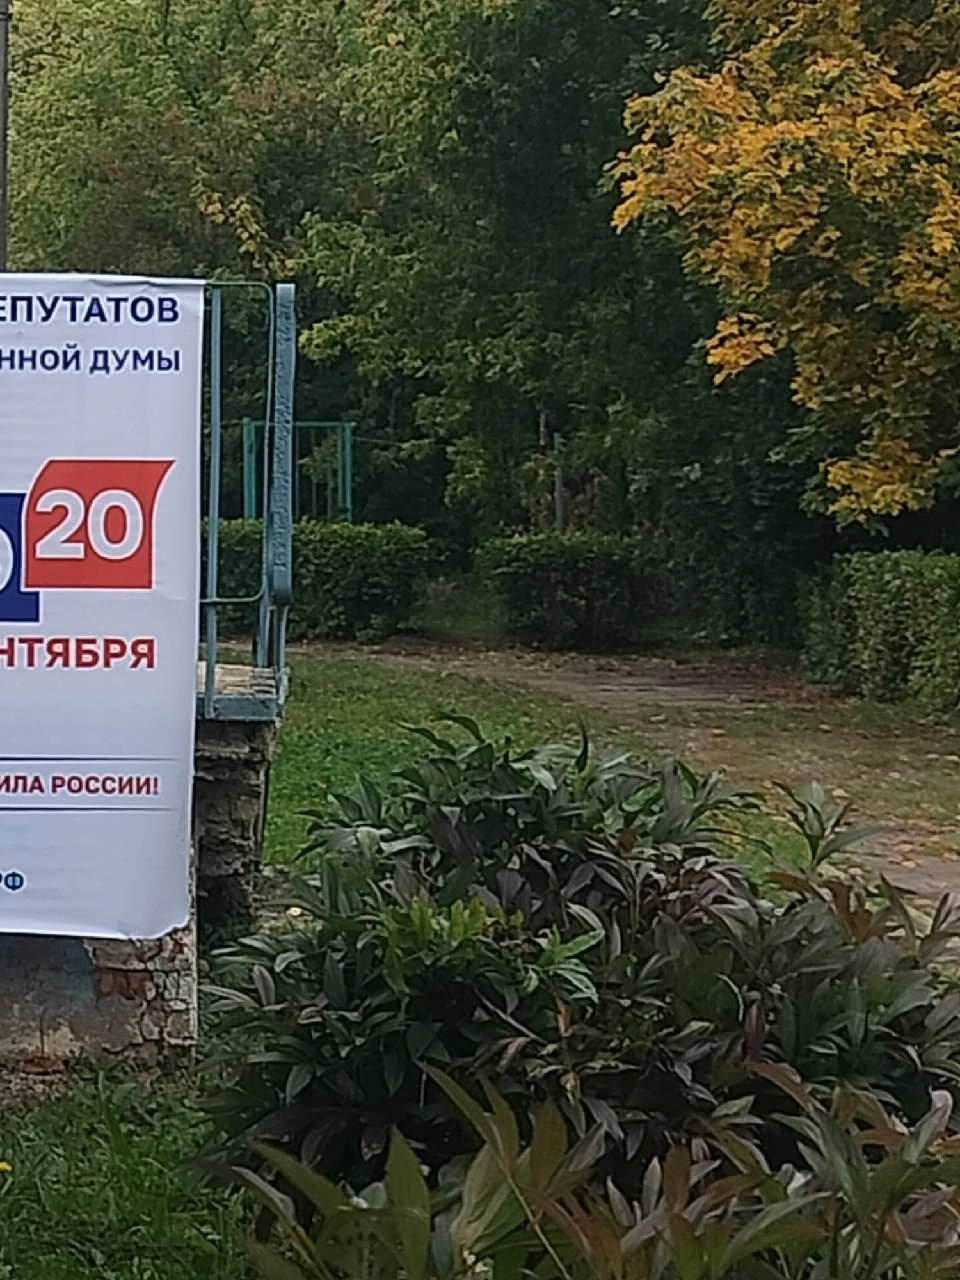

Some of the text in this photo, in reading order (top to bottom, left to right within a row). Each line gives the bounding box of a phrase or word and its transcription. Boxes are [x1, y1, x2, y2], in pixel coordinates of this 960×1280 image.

[89, 349, 181, 375] ДУМЫ
[34, 489, 144, 561] 20
[51, 776, 159, 795] РОССИИ!
